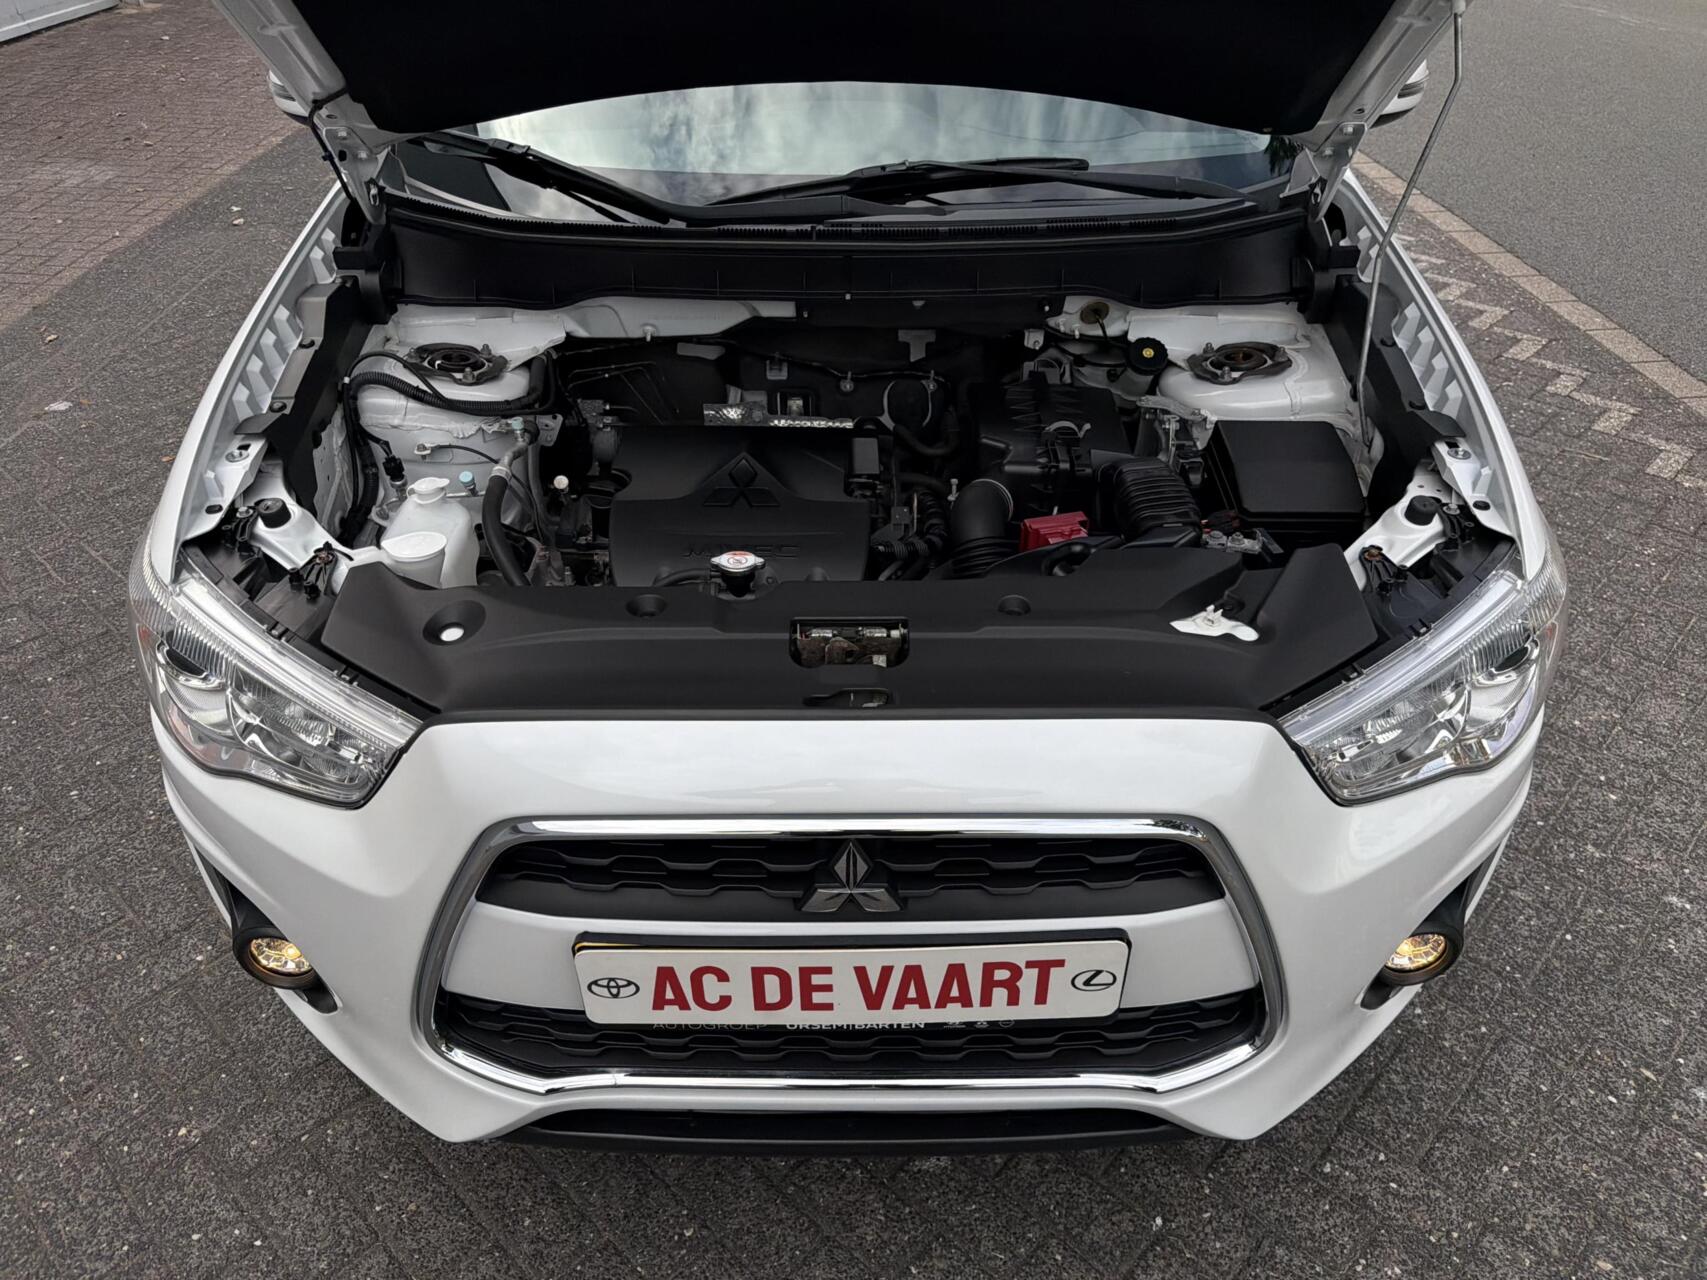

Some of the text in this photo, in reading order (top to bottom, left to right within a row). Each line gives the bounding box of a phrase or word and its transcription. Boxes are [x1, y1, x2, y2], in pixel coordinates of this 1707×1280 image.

[653, 959, 1065, 1011] AC DE VAART
